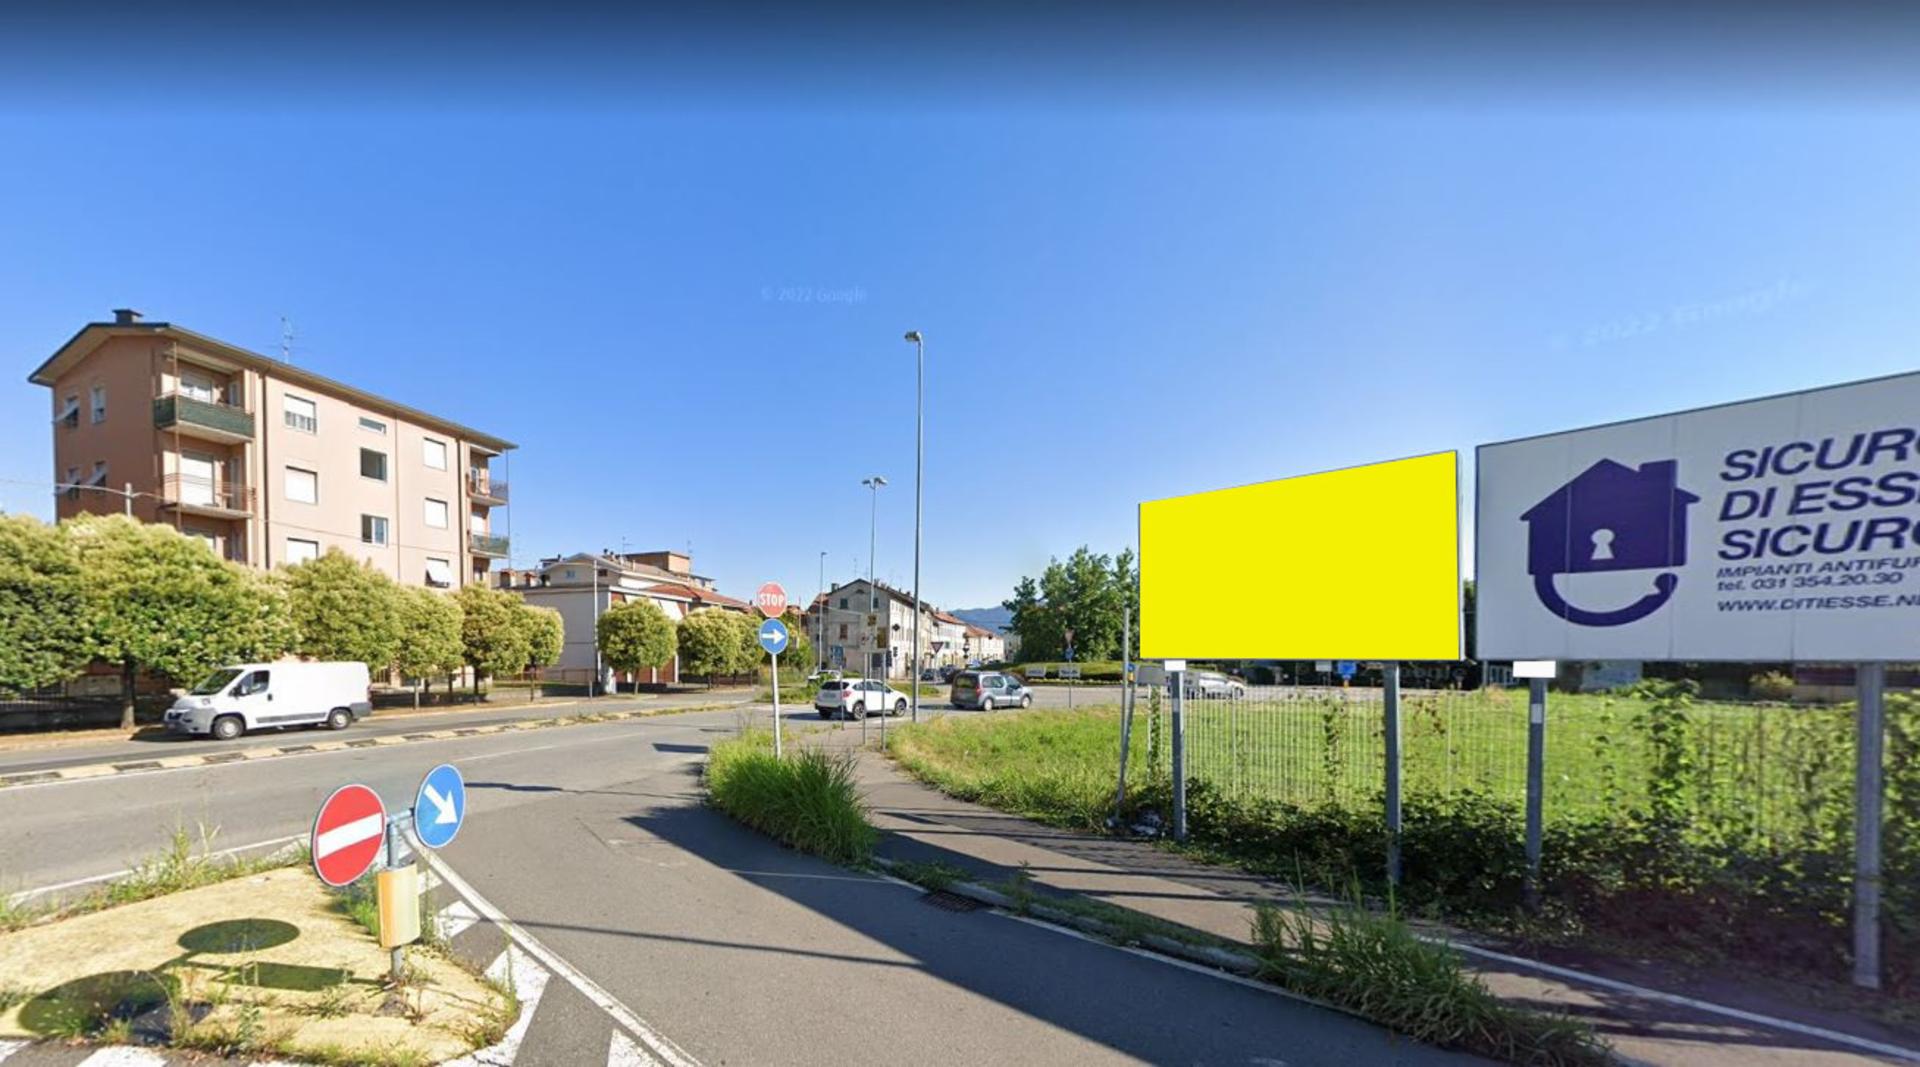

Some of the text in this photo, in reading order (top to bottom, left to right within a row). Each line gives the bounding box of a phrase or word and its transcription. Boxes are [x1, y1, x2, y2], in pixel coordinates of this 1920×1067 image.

[1719, 427, 1920, 482] SICUR
[1718, 471, 1920, 522] DI ESS
[1716, 563, 1813, 578] IMPIANTI
[1752, 578, 1787, 591] 031
[1793, 572, 1904, 589] 354.20.30
[760, 593, 785, 608] STOP
